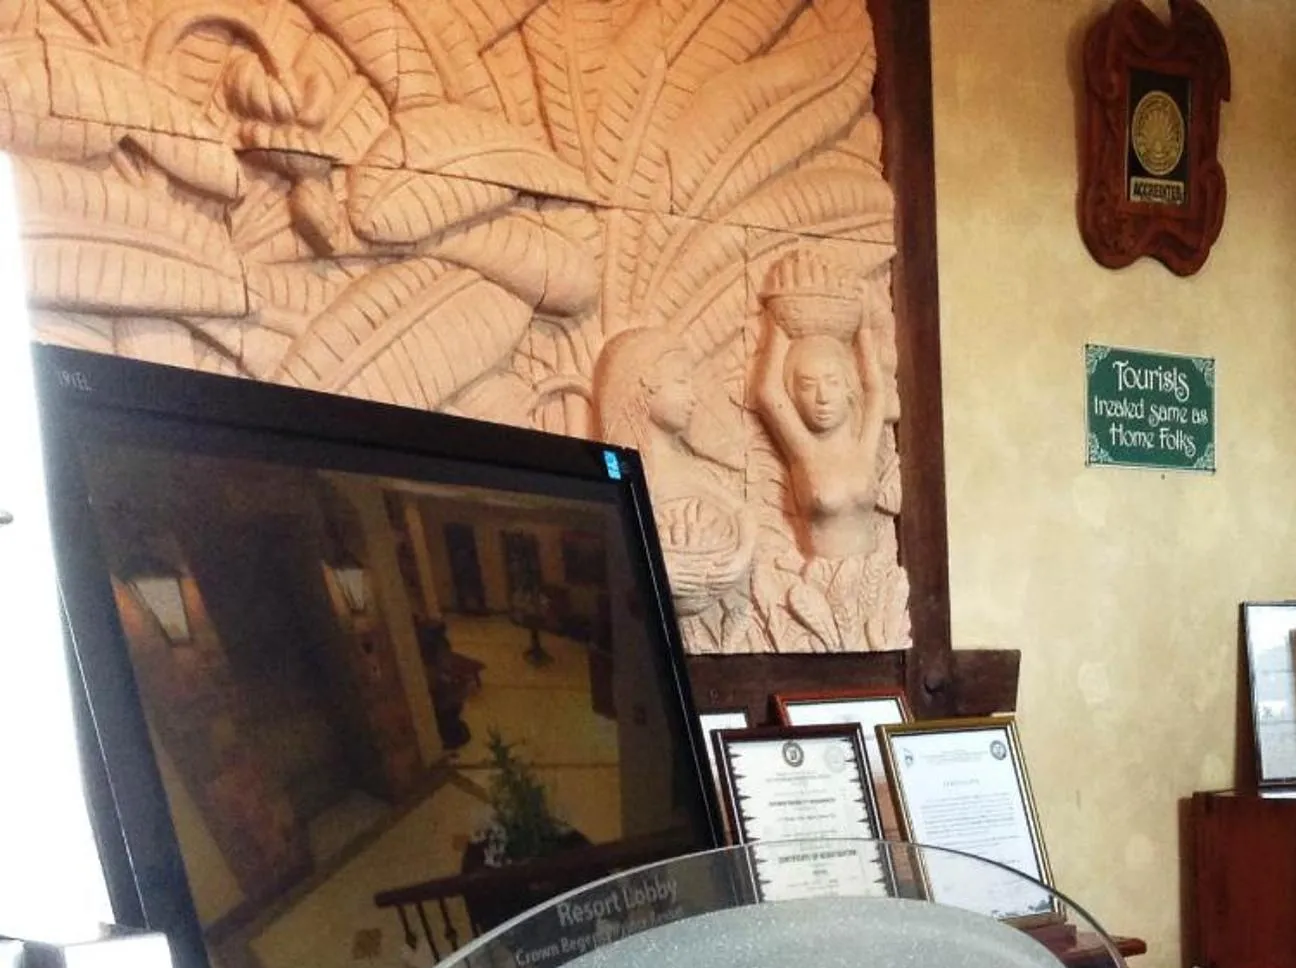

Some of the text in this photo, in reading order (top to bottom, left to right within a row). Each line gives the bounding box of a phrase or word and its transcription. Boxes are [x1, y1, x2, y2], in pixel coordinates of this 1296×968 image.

[1112, 360, 1190, 402] Tourists
[1149, 403, 1188, 427] same
[1191, 408, 1208, 425] as
[1109, 422, 1197, 458] Home Folks
[555, 891, 622, 927] Resort
[622, 873, 678, 909] Lobby
[515, 941, 560, 967] Crown
